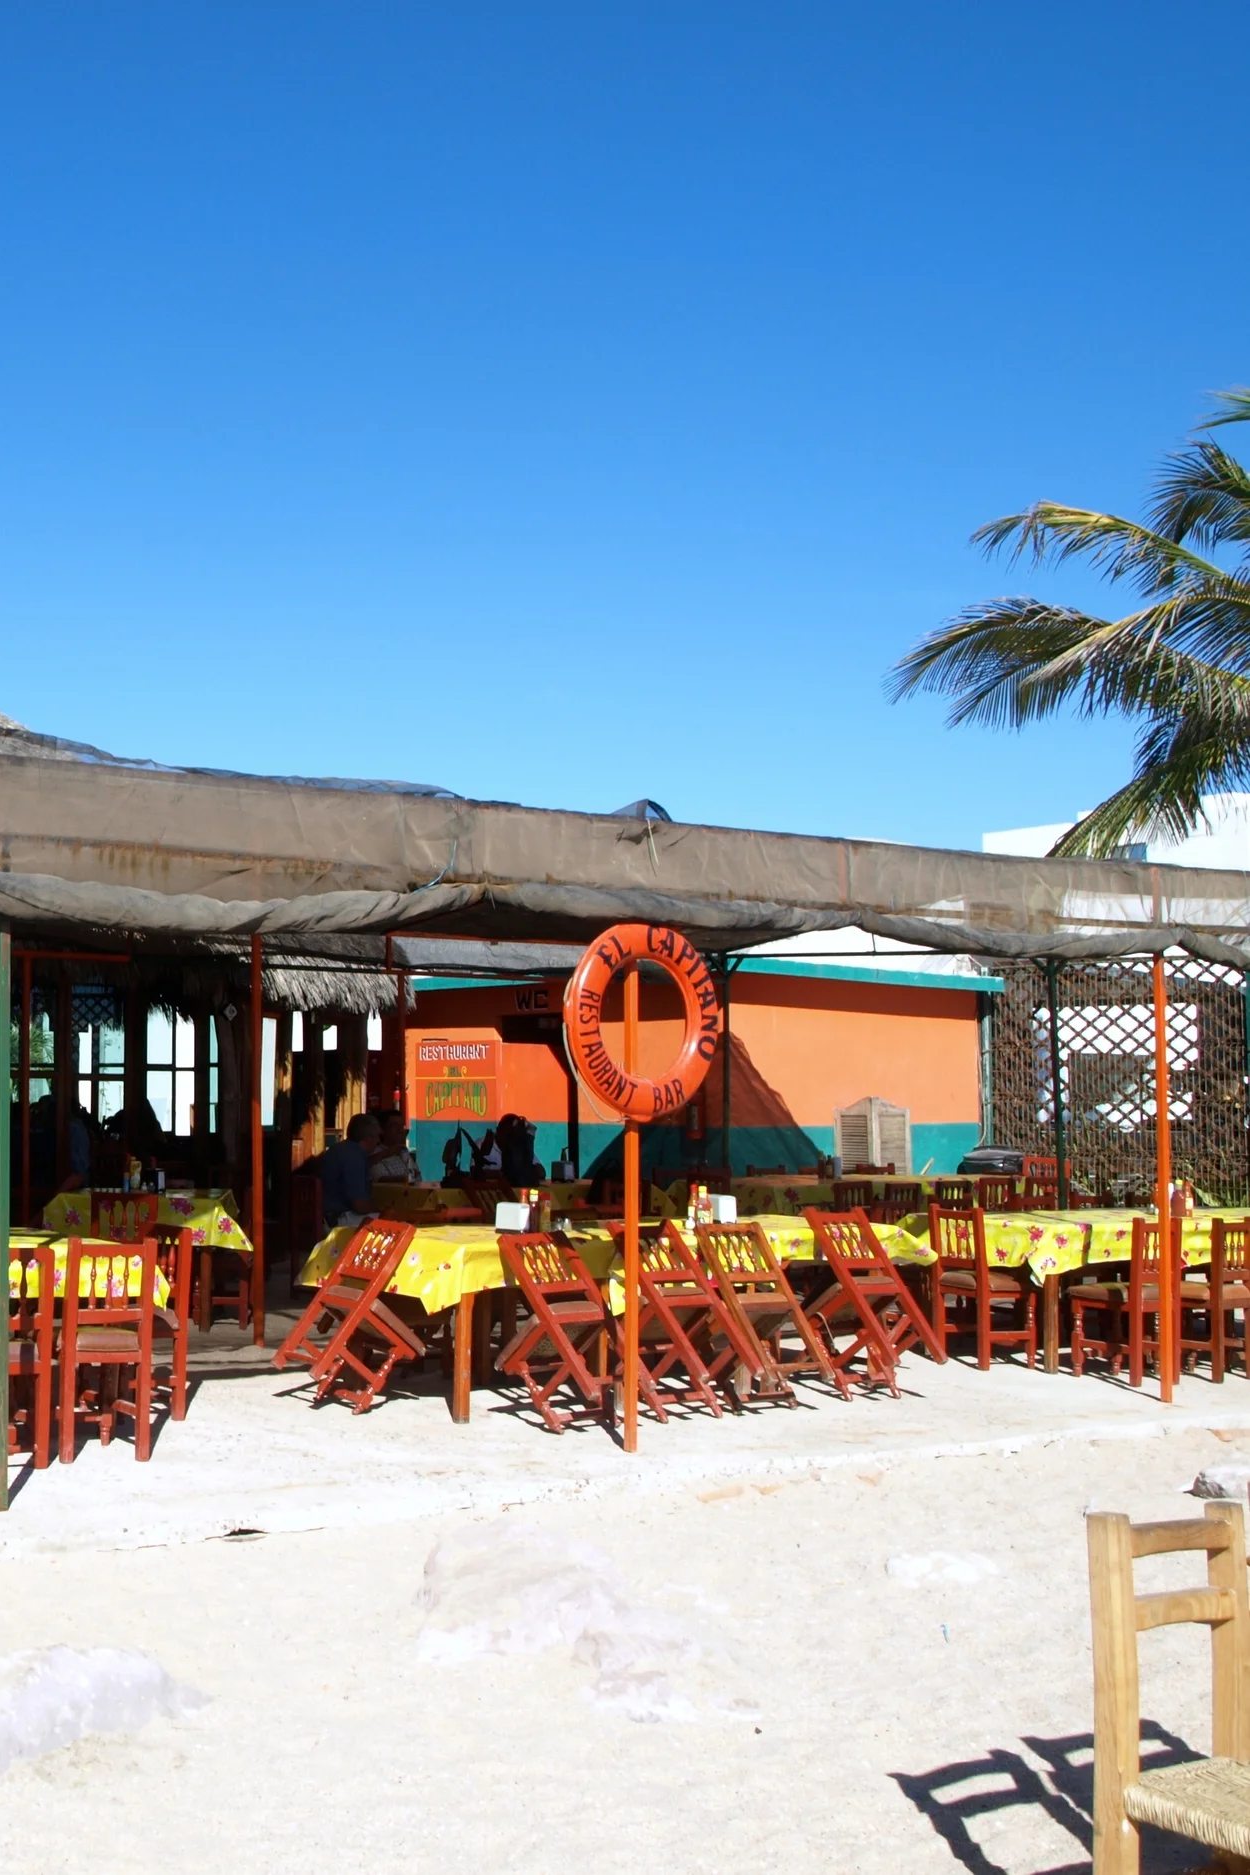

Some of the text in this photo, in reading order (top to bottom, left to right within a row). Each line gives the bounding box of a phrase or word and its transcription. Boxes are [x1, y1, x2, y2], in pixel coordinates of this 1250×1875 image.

[595, 926, 719, 1062] EL CAPITANO
[419, 1044, 490, 1062] RESTAURANT
[579, 988, 686, 1113] RESTAURANT BAR
[448, 1066, 462, 1077] EL
[425, 1081, 488, 1118] CAPITANO
